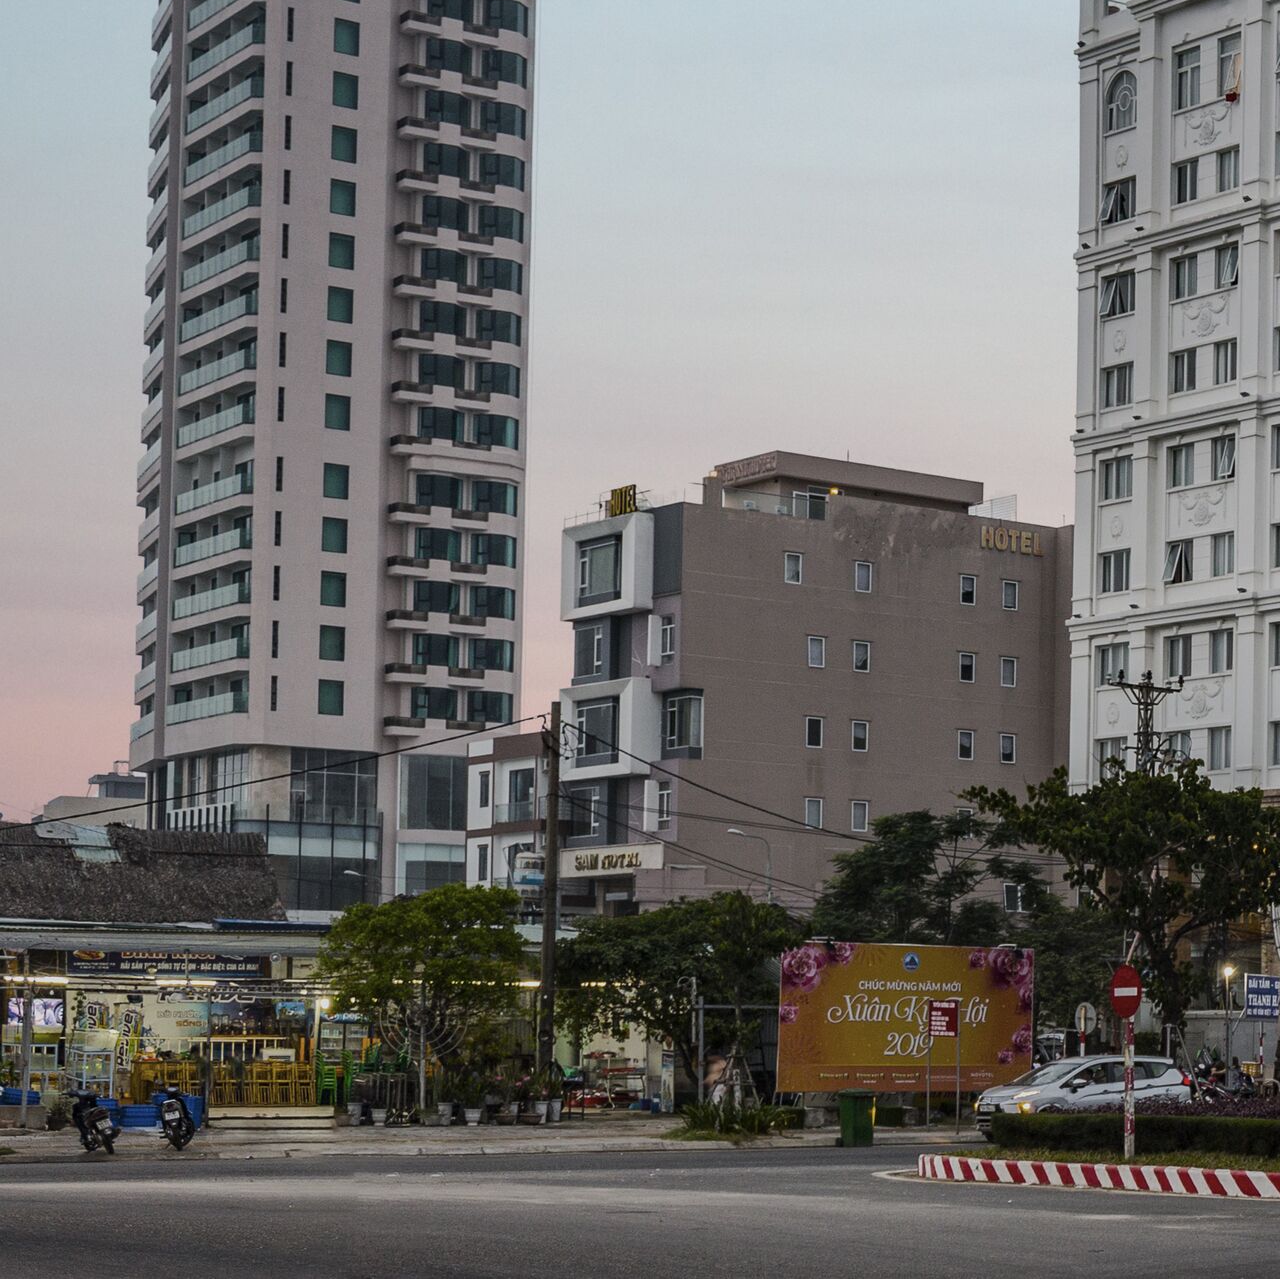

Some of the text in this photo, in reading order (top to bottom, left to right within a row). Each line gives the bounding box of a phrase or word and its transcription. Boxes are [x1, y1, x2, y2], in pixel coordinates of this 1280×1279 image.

[610, 484, 637, 517] HOTEL
[981, 525, 1045, 557] HOTEL
[575, 852, 642, 871] SAM HOTEL
[858, 978, 962, 992] CHÚC MỪNG NĂM MỚI
[827, 993, 892, 1024] Xuân
[1248, 994, 1271, 1006] THANH
[884, 1032, 934, 1058] 2019
